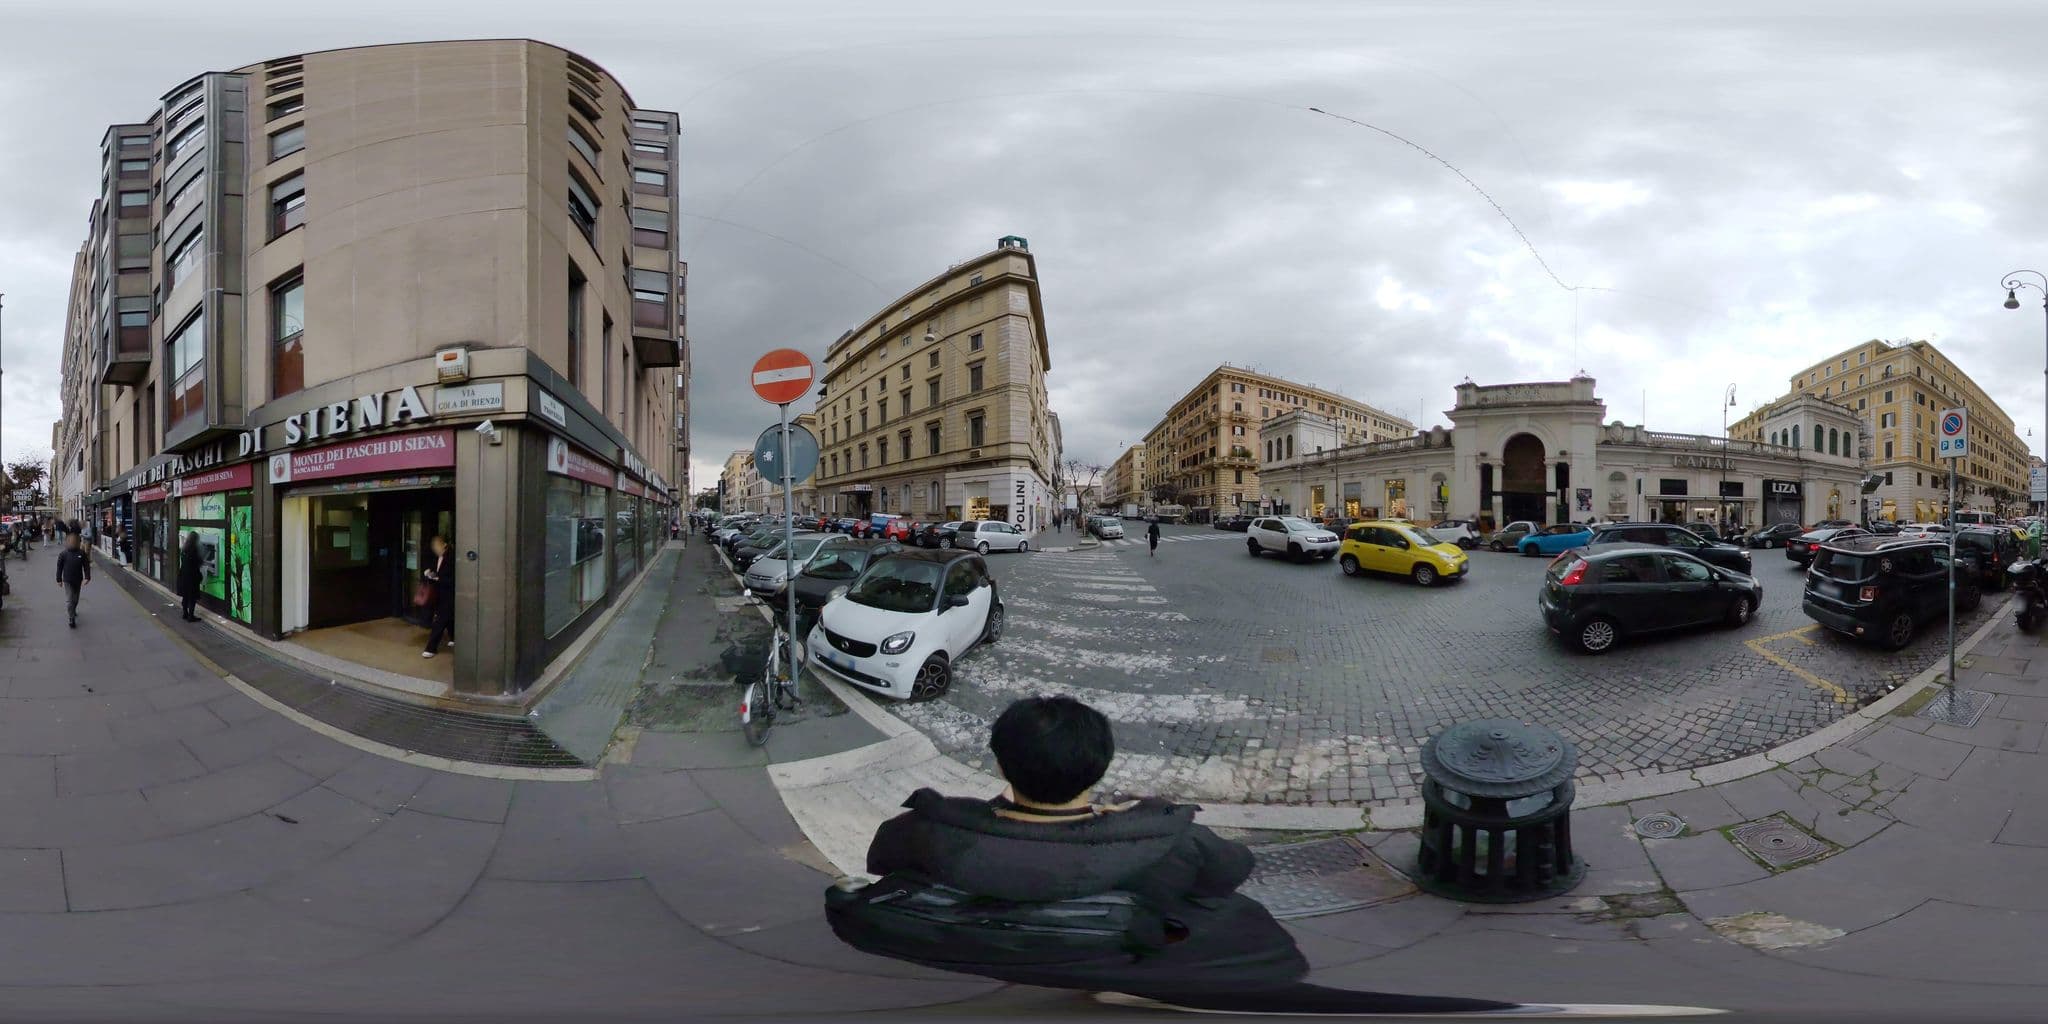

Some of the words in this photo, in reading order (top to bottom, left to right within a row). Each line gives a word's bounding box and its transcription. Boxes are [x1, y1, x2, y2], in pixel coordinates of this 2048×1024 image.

[438, 402, 457, 410] COLA
[461, 400, 468, 408] DI
[472, 397, 500, 406] RIENZO
[151, 464, 165, 482] DEI
[172, 442, 223, 476] PASCHI
[239, 427, 262, 457] DI
[286, 386, 429, 446] SIENA
[294, 452, 325, 467] MONTE
[327, 448, 343, 462] DEI
[346, 441, 387, 459] PASCHI
[390, 439, 402, 453] DI
[405, 435, 446, 451] SIENA
[1772, 482, 1797, 494] LIZA
[1015, 480, 1026, 532] POLLINI
